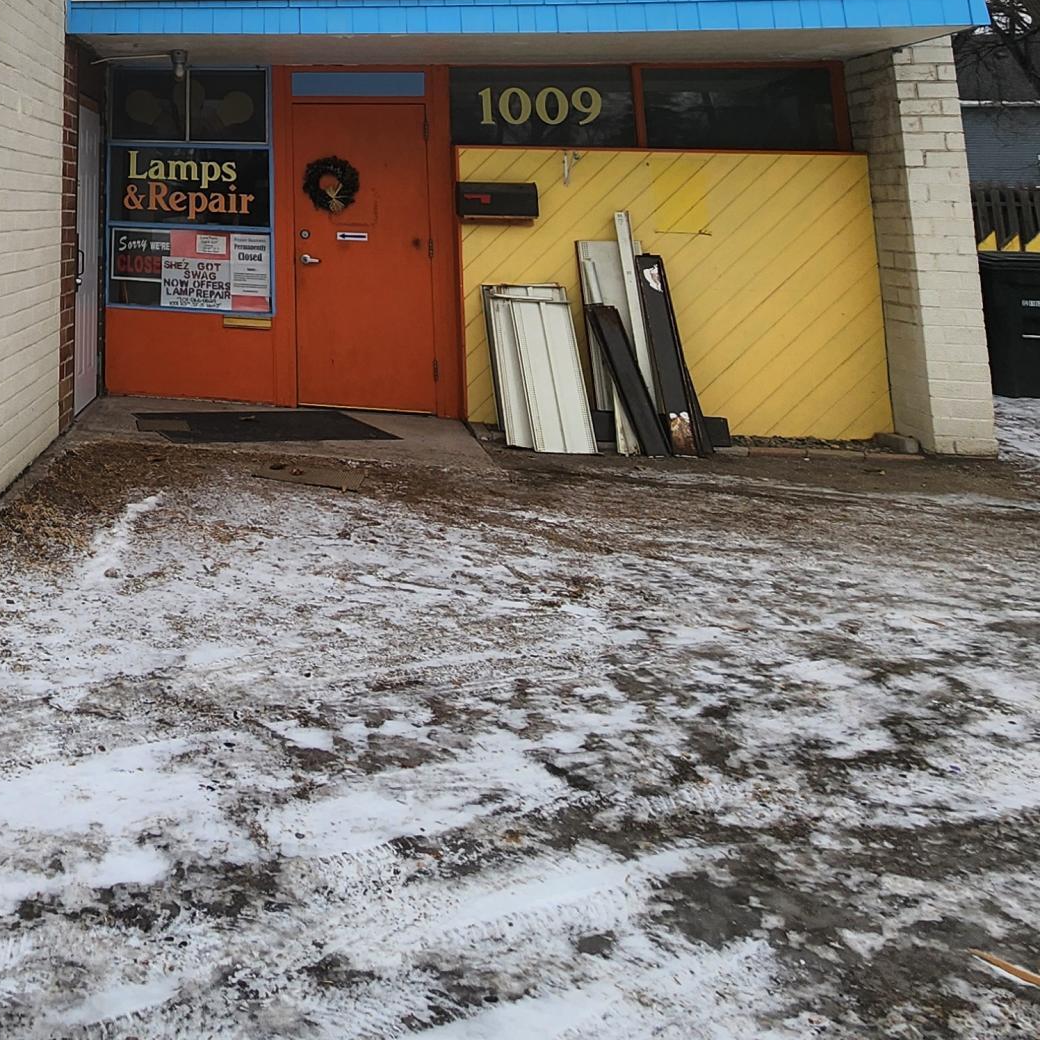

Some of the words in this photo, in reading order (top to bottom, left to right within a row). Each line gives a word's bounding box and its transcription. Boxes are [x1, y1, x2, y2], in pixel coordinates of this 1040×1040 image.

[478, 87, 602, 125] 1009
[128, 150, 237, 189] Lamps
[118, 236, 147, 252] Sorry
[238, 252, 263, 261] Closed
[117, 255, 162, 273] CLOSE
[197, 262, 221, 271] GOT
[183, 270, 217, 280] SWAG
[163, 278, 189, 288] NOW
[192, 280, 231, 291] OFFERS
